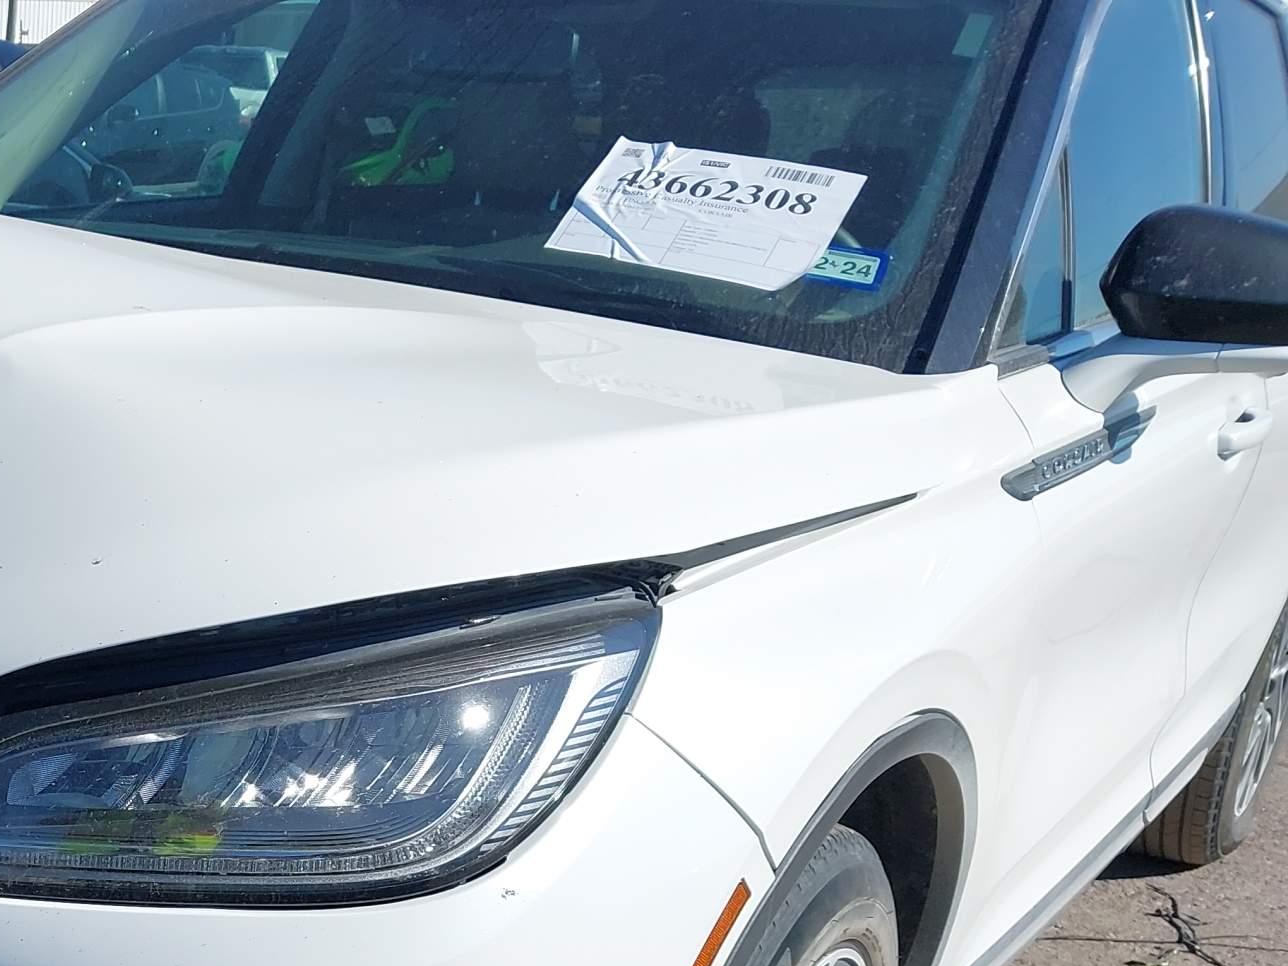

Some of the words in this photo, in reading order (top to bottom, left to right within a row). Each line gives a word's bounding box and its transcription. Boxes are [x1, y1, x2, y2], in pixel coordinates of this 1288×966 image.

[617, 167, 817, 215] 43662308
[698, 199, 750, 214] Insurance
[839, 261, 873, 278] 24
